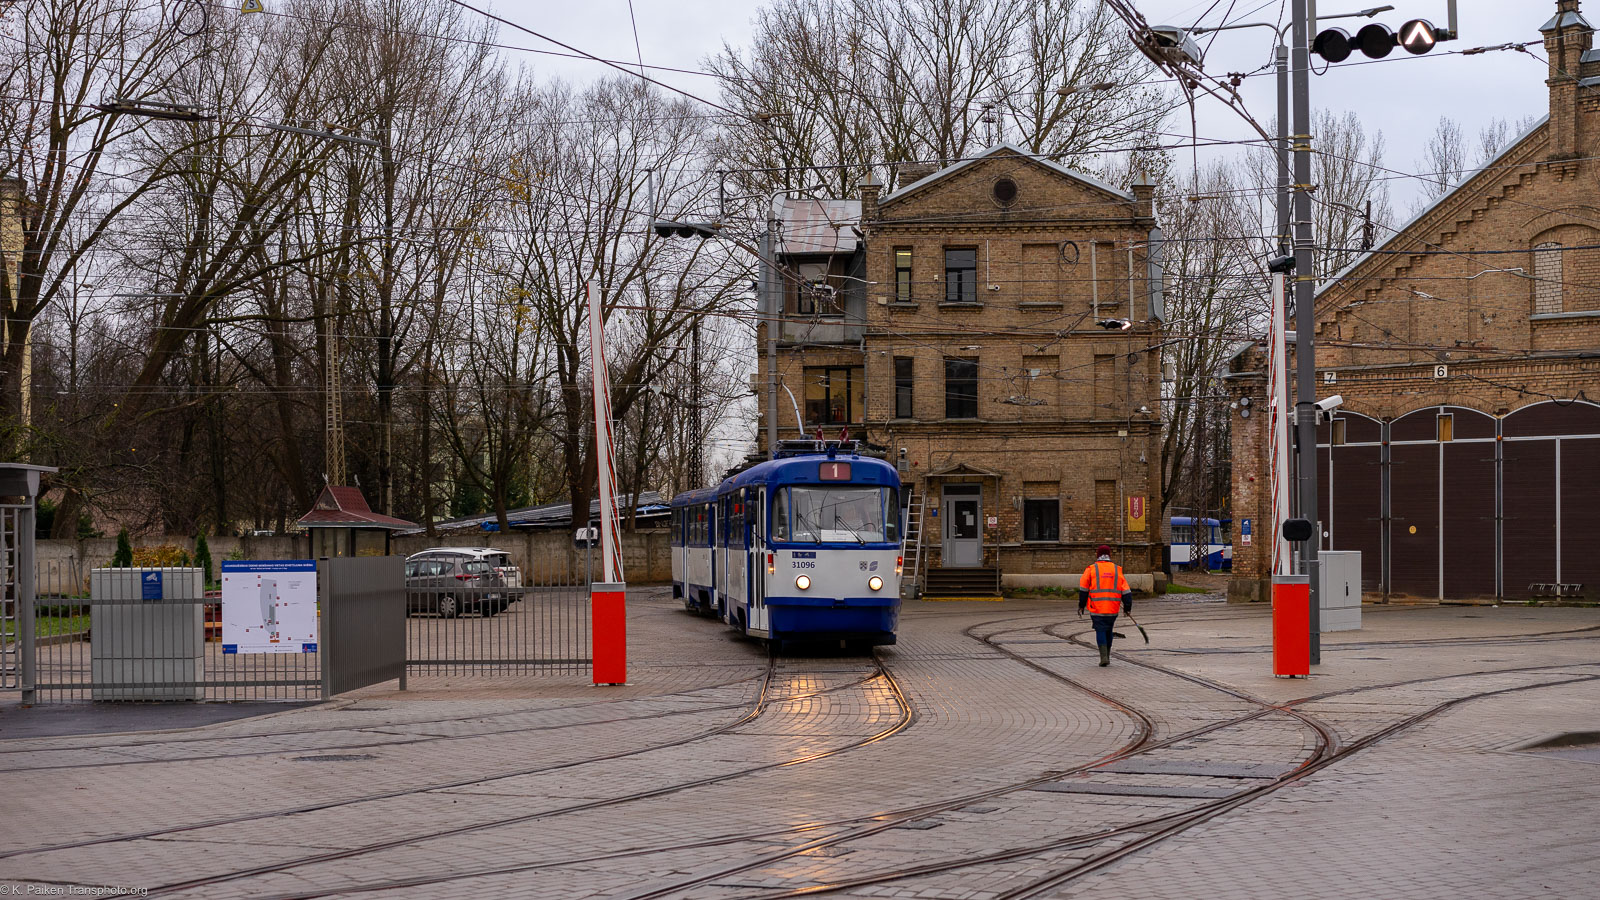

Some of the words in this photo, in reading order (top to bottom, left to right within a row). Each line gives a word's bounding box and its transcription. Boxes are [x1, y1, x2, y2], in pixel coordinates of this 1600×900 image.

[1437, 366, 1445, 377] 6
[1327, 373, 1334, 383] 7
[832, 463, 838, 478] 1
[792, 561, 815, 569] 31096
